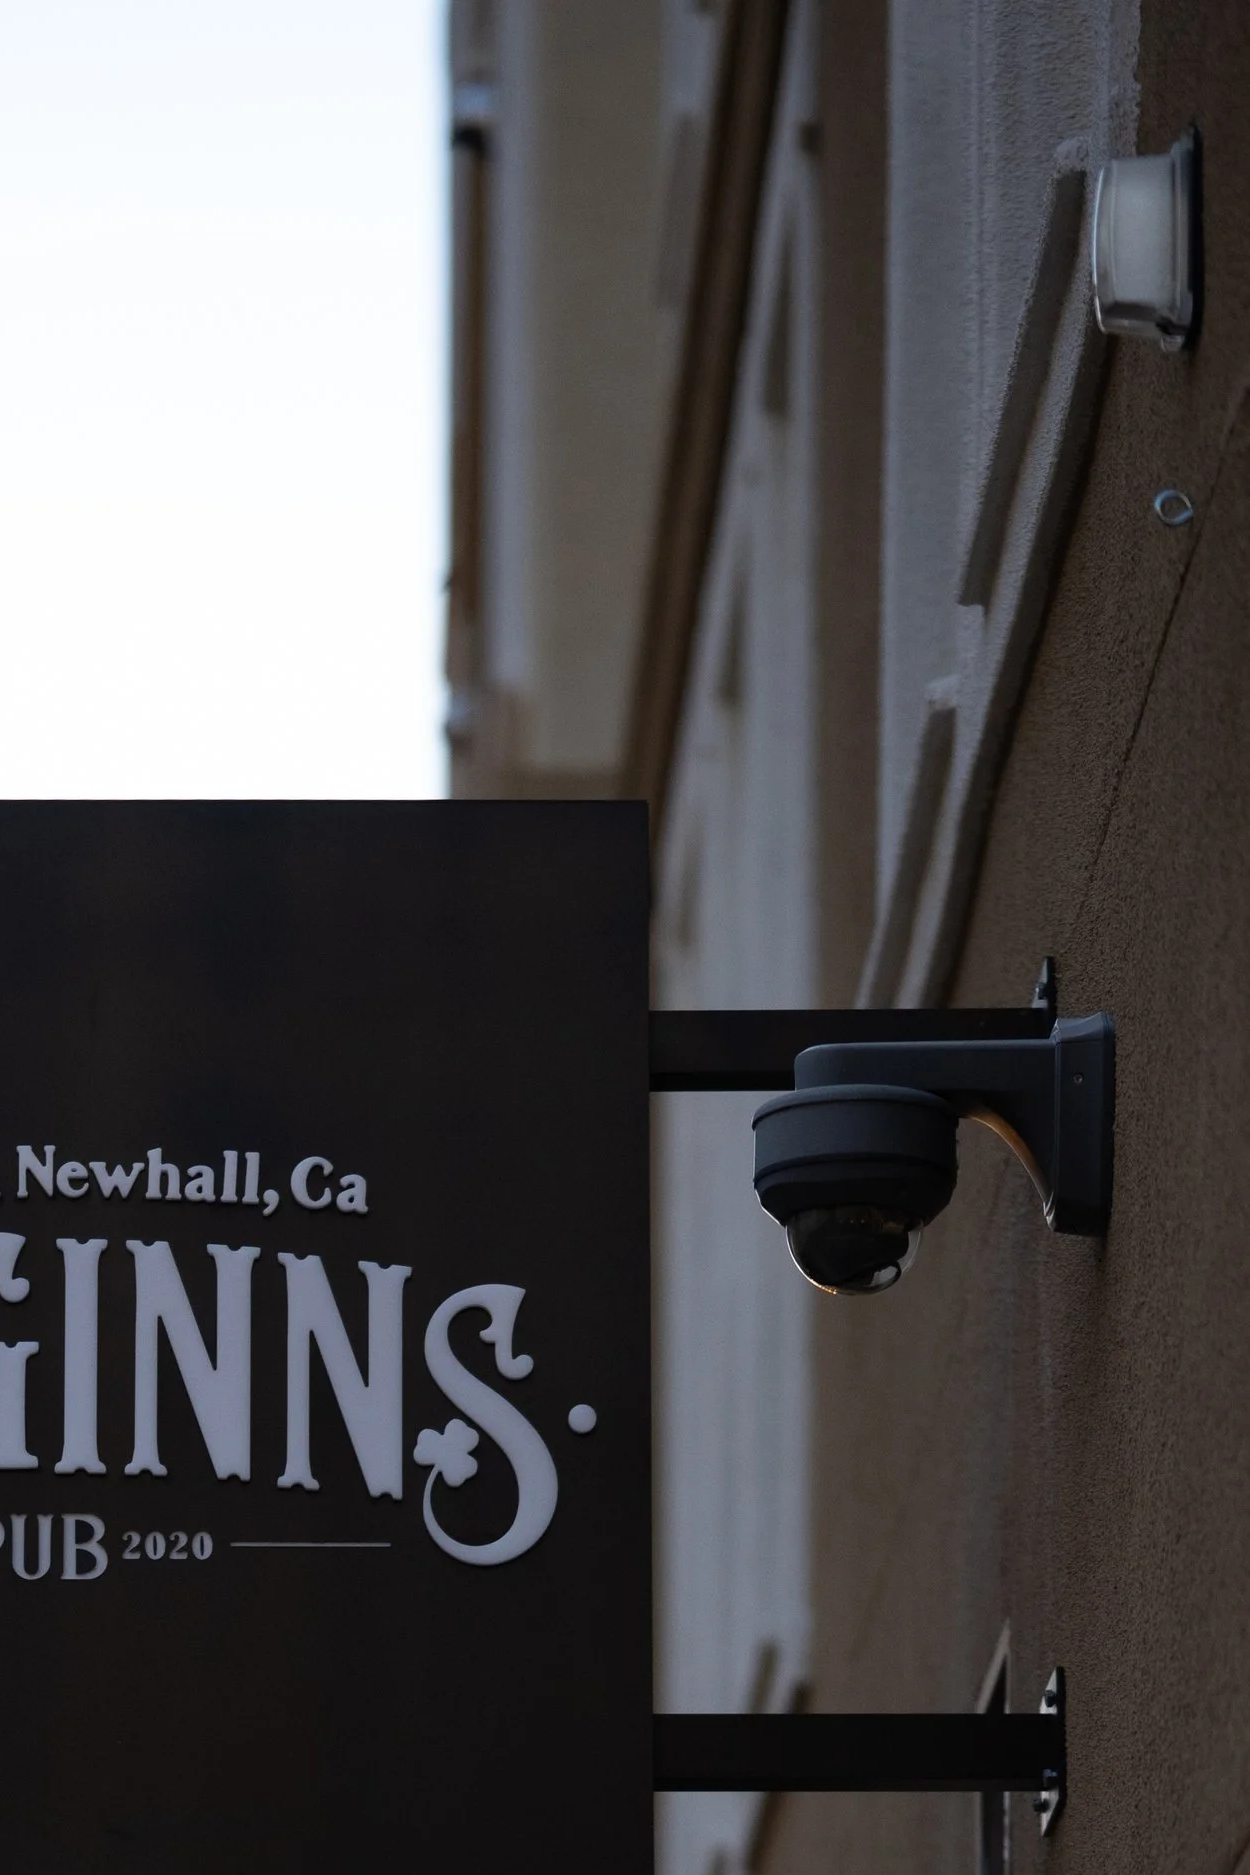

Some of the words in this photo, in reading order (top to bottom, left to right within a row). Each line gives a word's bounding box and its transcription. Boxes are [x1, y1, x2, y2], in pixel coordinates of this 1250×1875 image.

[16, 1144, 281, 1216] Newhall,
[290, 1156, 369, 1213] Ca
[122, 1531, 214, 1561] 2020
